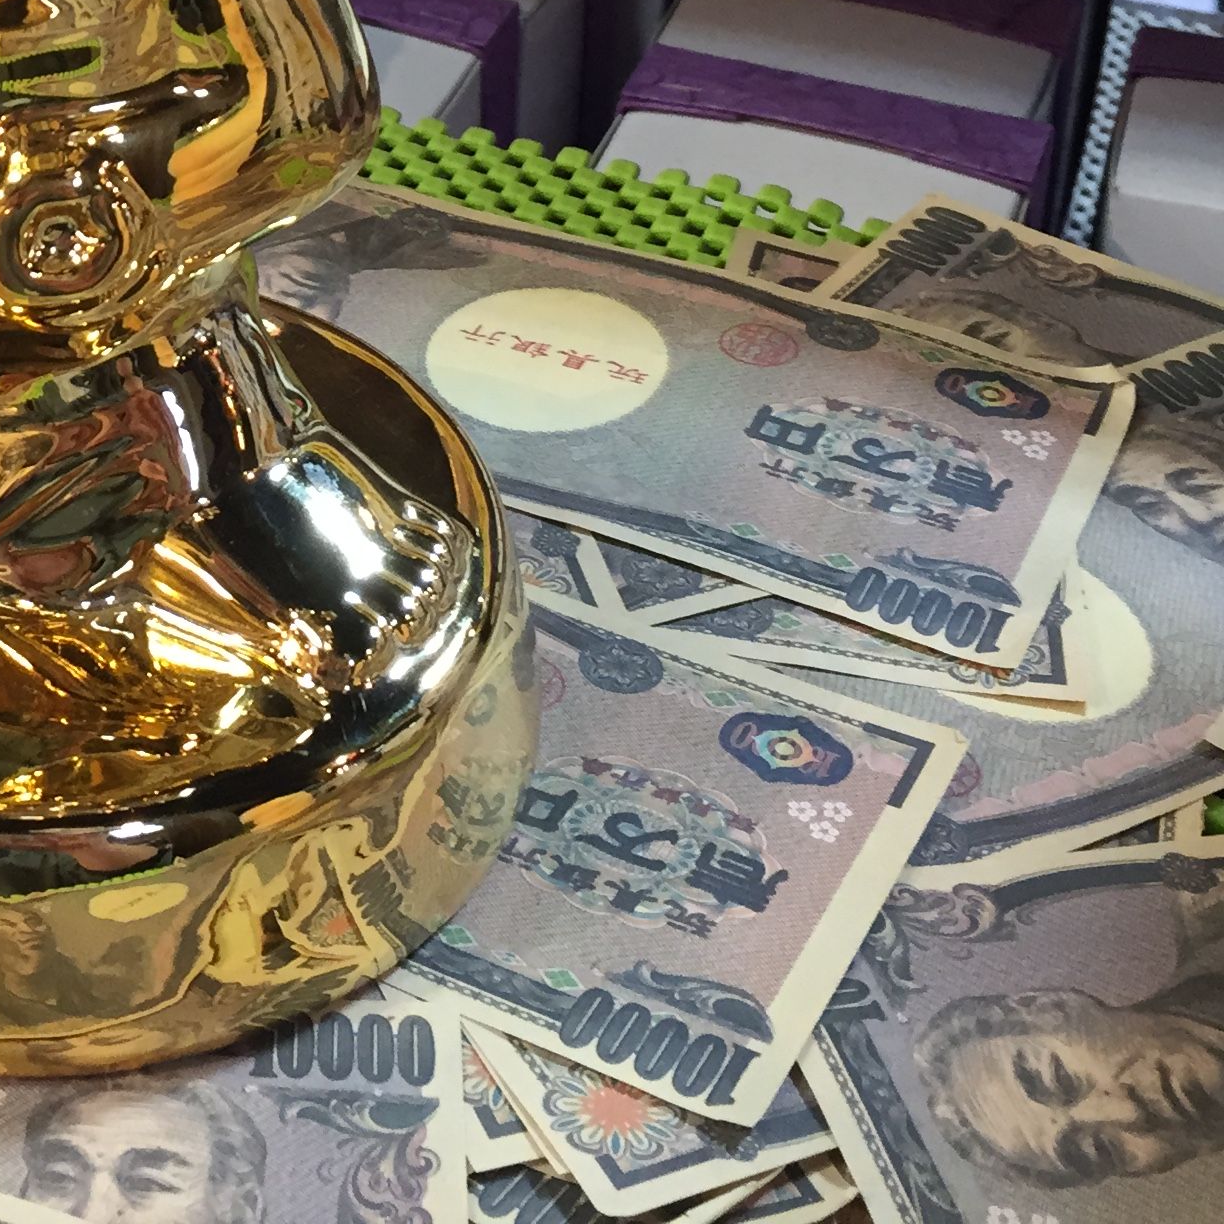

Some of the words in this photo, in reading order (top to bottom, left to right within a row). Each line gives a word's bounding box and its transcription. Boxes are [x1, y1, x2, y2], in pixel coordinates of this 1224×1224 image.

[877, 207, 987, 277] 10000
[460, 322, 650, 386] 玩具銀行
[846, 566, 1016, 654] 10000
[249, 1011, 436, 1087] 10000
[559, 988, 762, 1108] 10000
